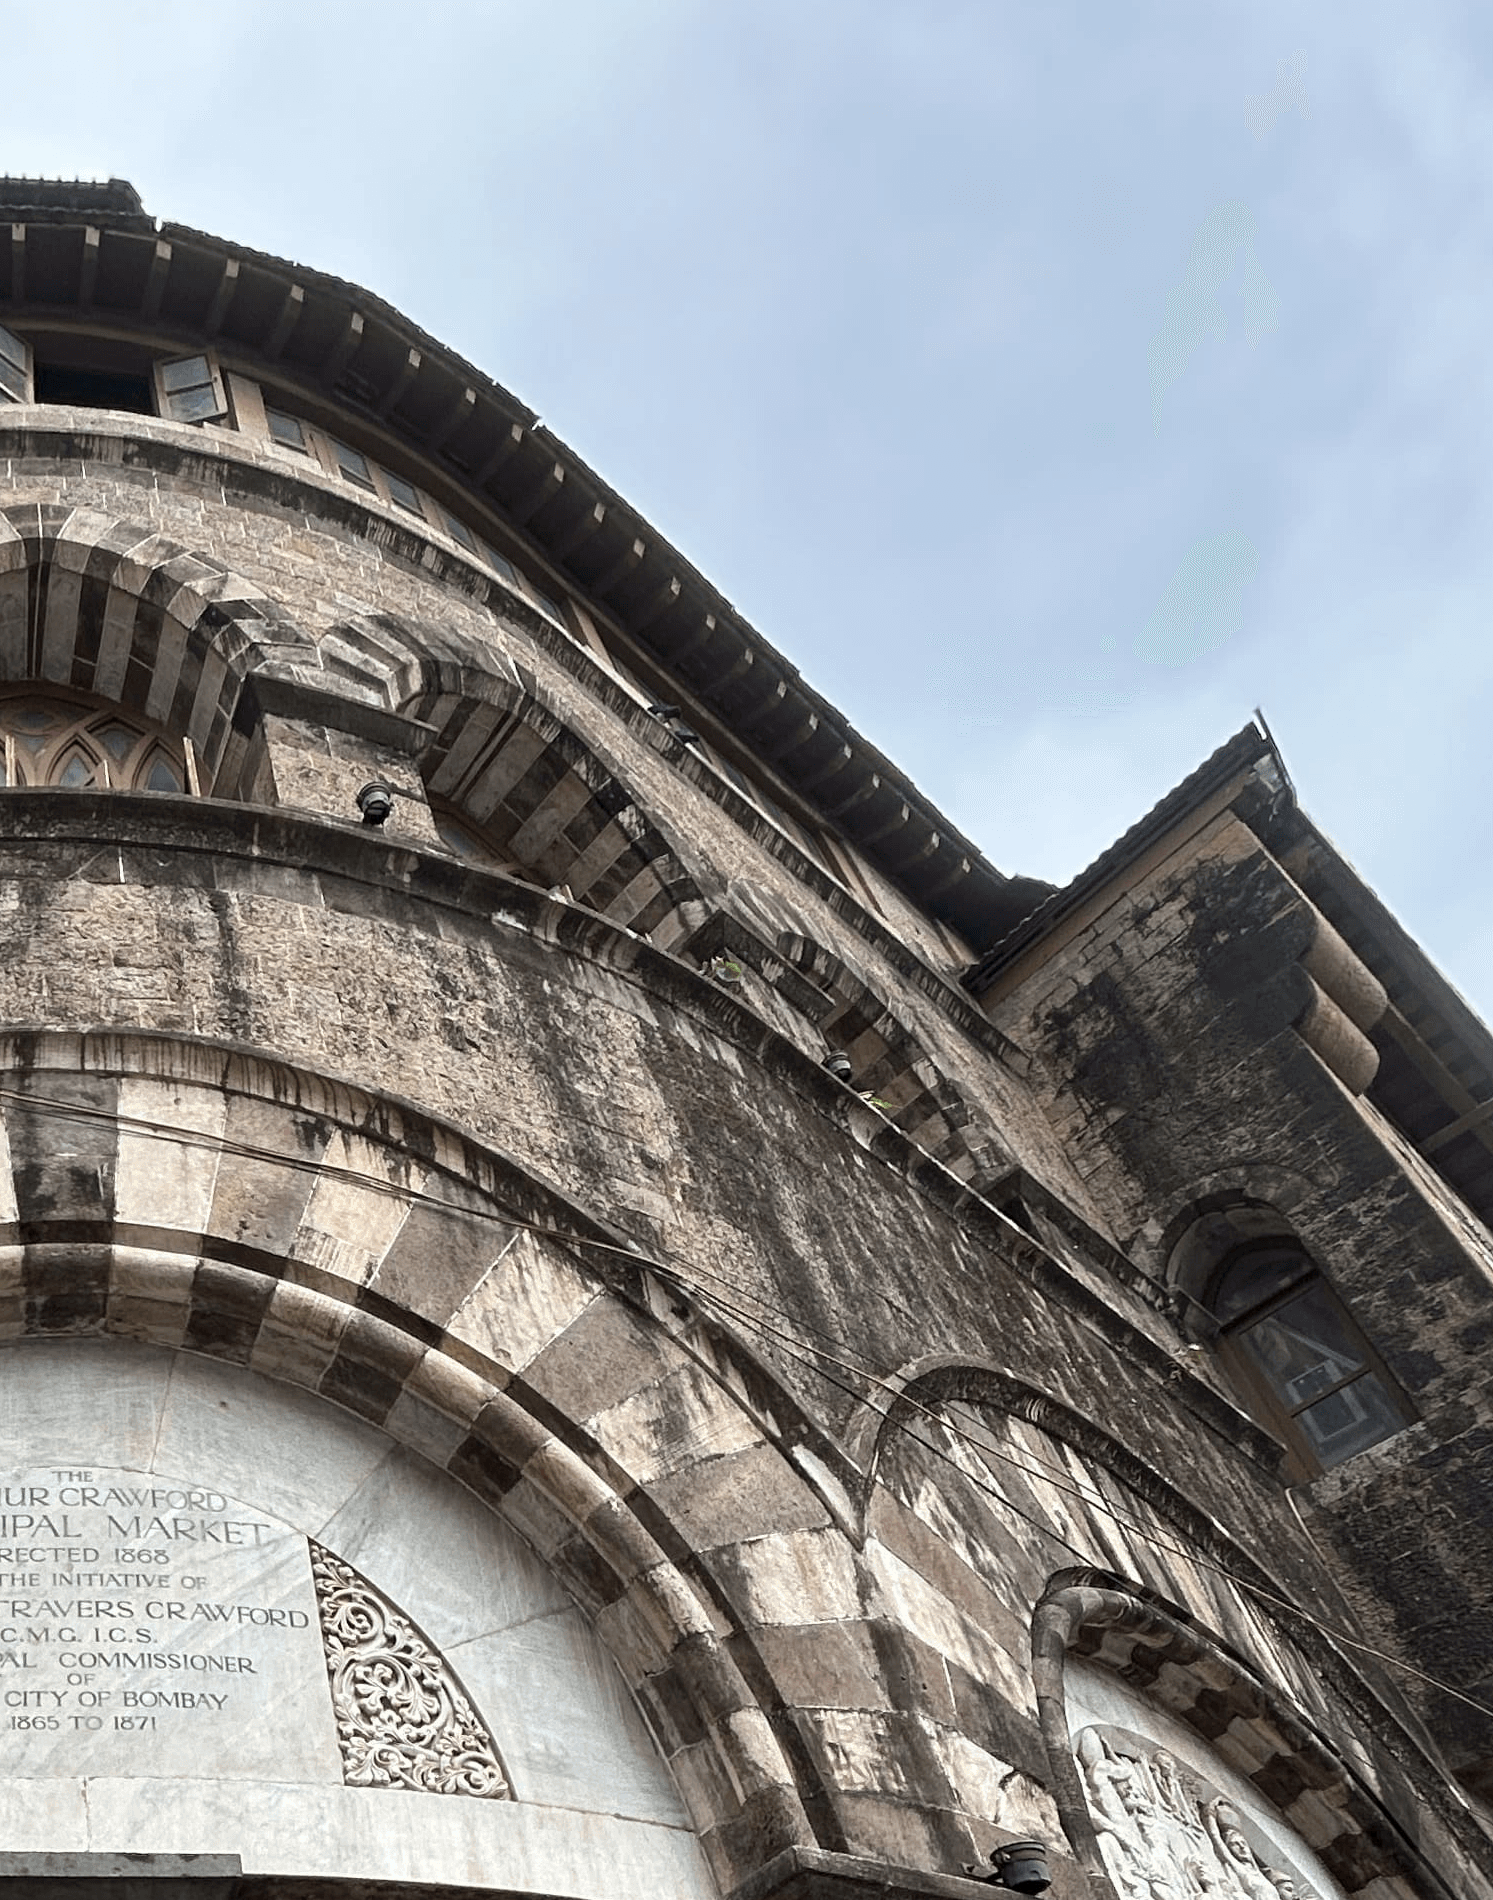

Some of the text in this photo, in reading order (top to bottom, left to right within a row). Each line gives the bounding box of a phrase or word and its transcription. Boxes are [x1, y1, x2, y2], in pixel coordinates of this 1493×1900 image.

[51, 1470, 94, 1483] THE
[58, 1487, 228, 1513] CRAWFORD
[107, 1514, 271, 1545] MARKET
[115, 1548, 170, 1565] 1868
[52, 1573, 171, 1588] INITIATIVE
[180, 1575, 208, 1590] OF
[145, 1600, 310, 1630] CRAWFORD
[0, 1627, 158, 1644] C.M.G. I.C.S.
[58, 1652, 257, 1675] COMMISSIONER
[66, 1673, 96, 1686] OF
[3, 1690, 69, 1708] CITY
[77, 1690, 112, 1708] OF
[122, 1690, 230, 1710] BOMBAY
[10, 1715, 158, 1731] 1865 TO 1871
